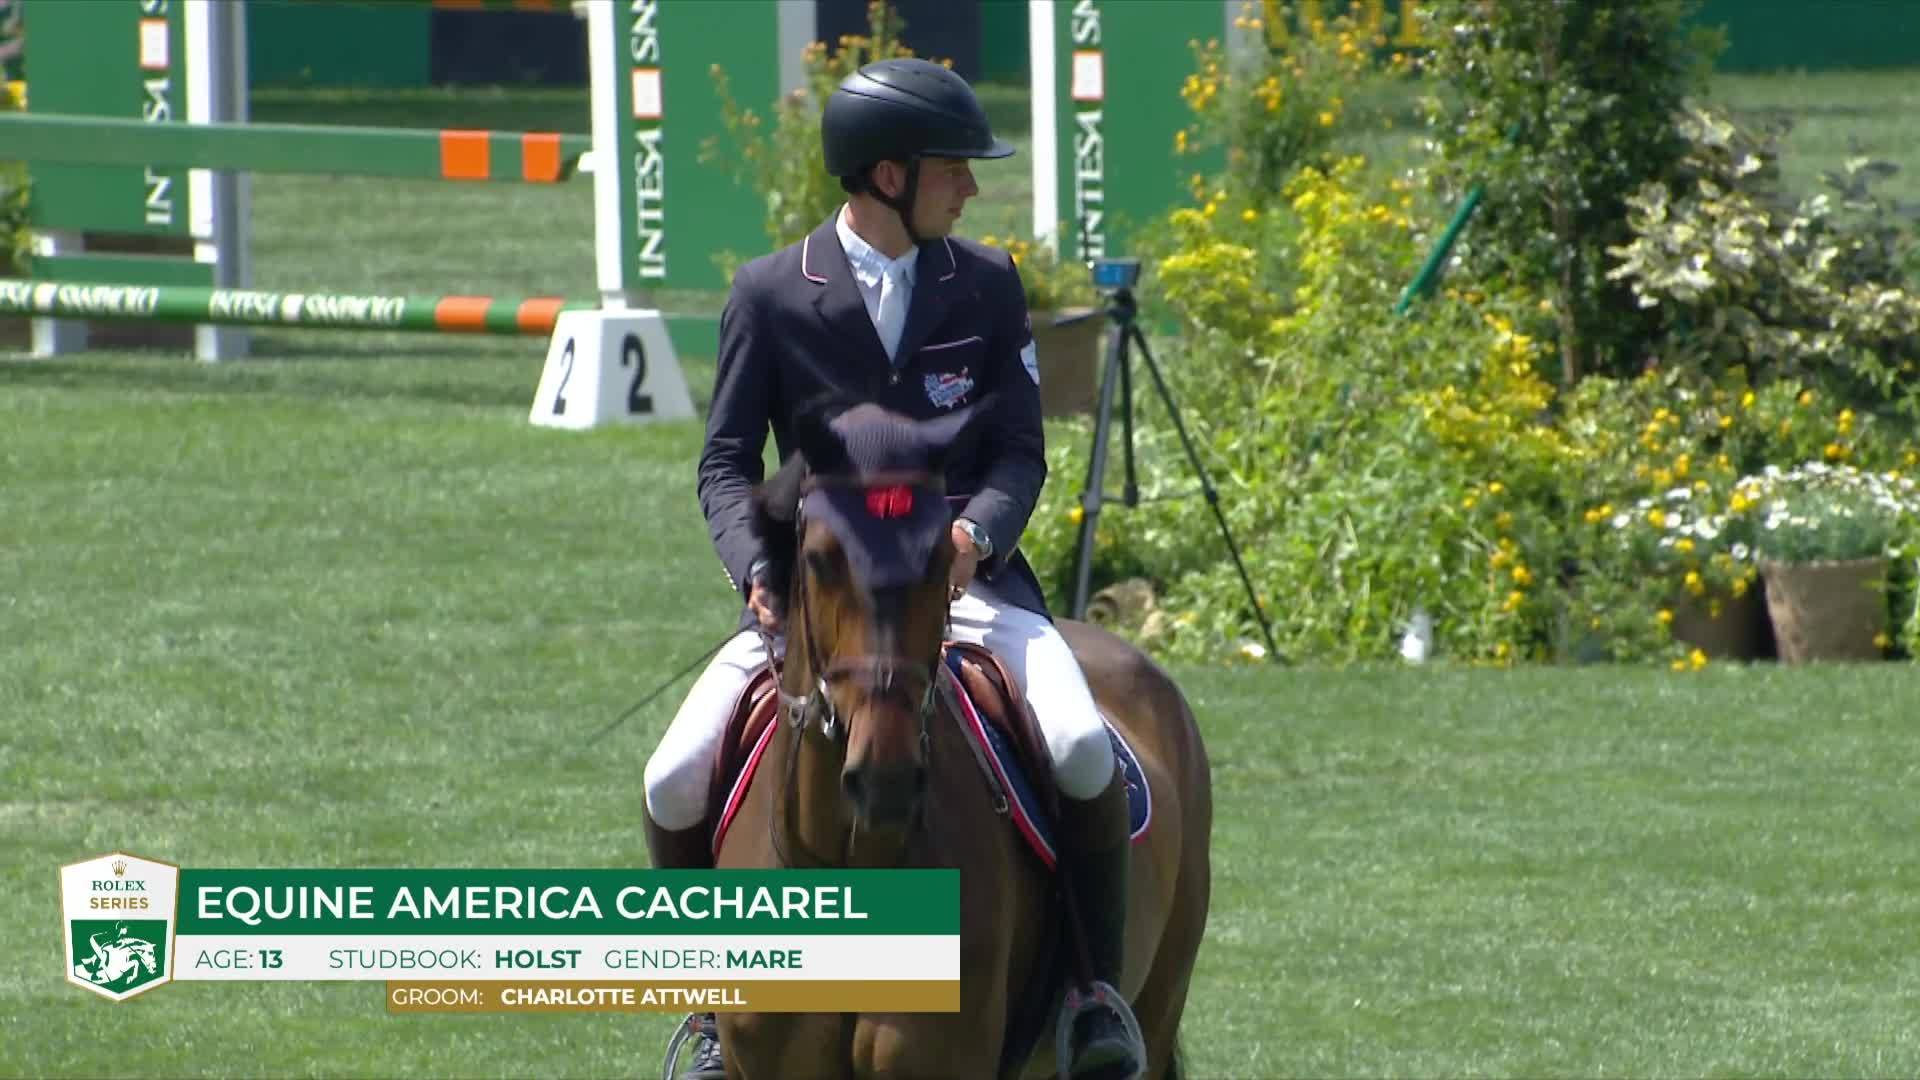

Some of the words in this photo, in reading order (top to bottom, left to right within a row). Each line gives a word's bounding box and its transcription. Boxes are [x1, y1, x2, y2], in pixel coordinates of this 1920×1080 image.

[635, 128, 666, 278] INTESA
[552, 337, 575, 415] 2
[621, 332, 653, 414] 2
